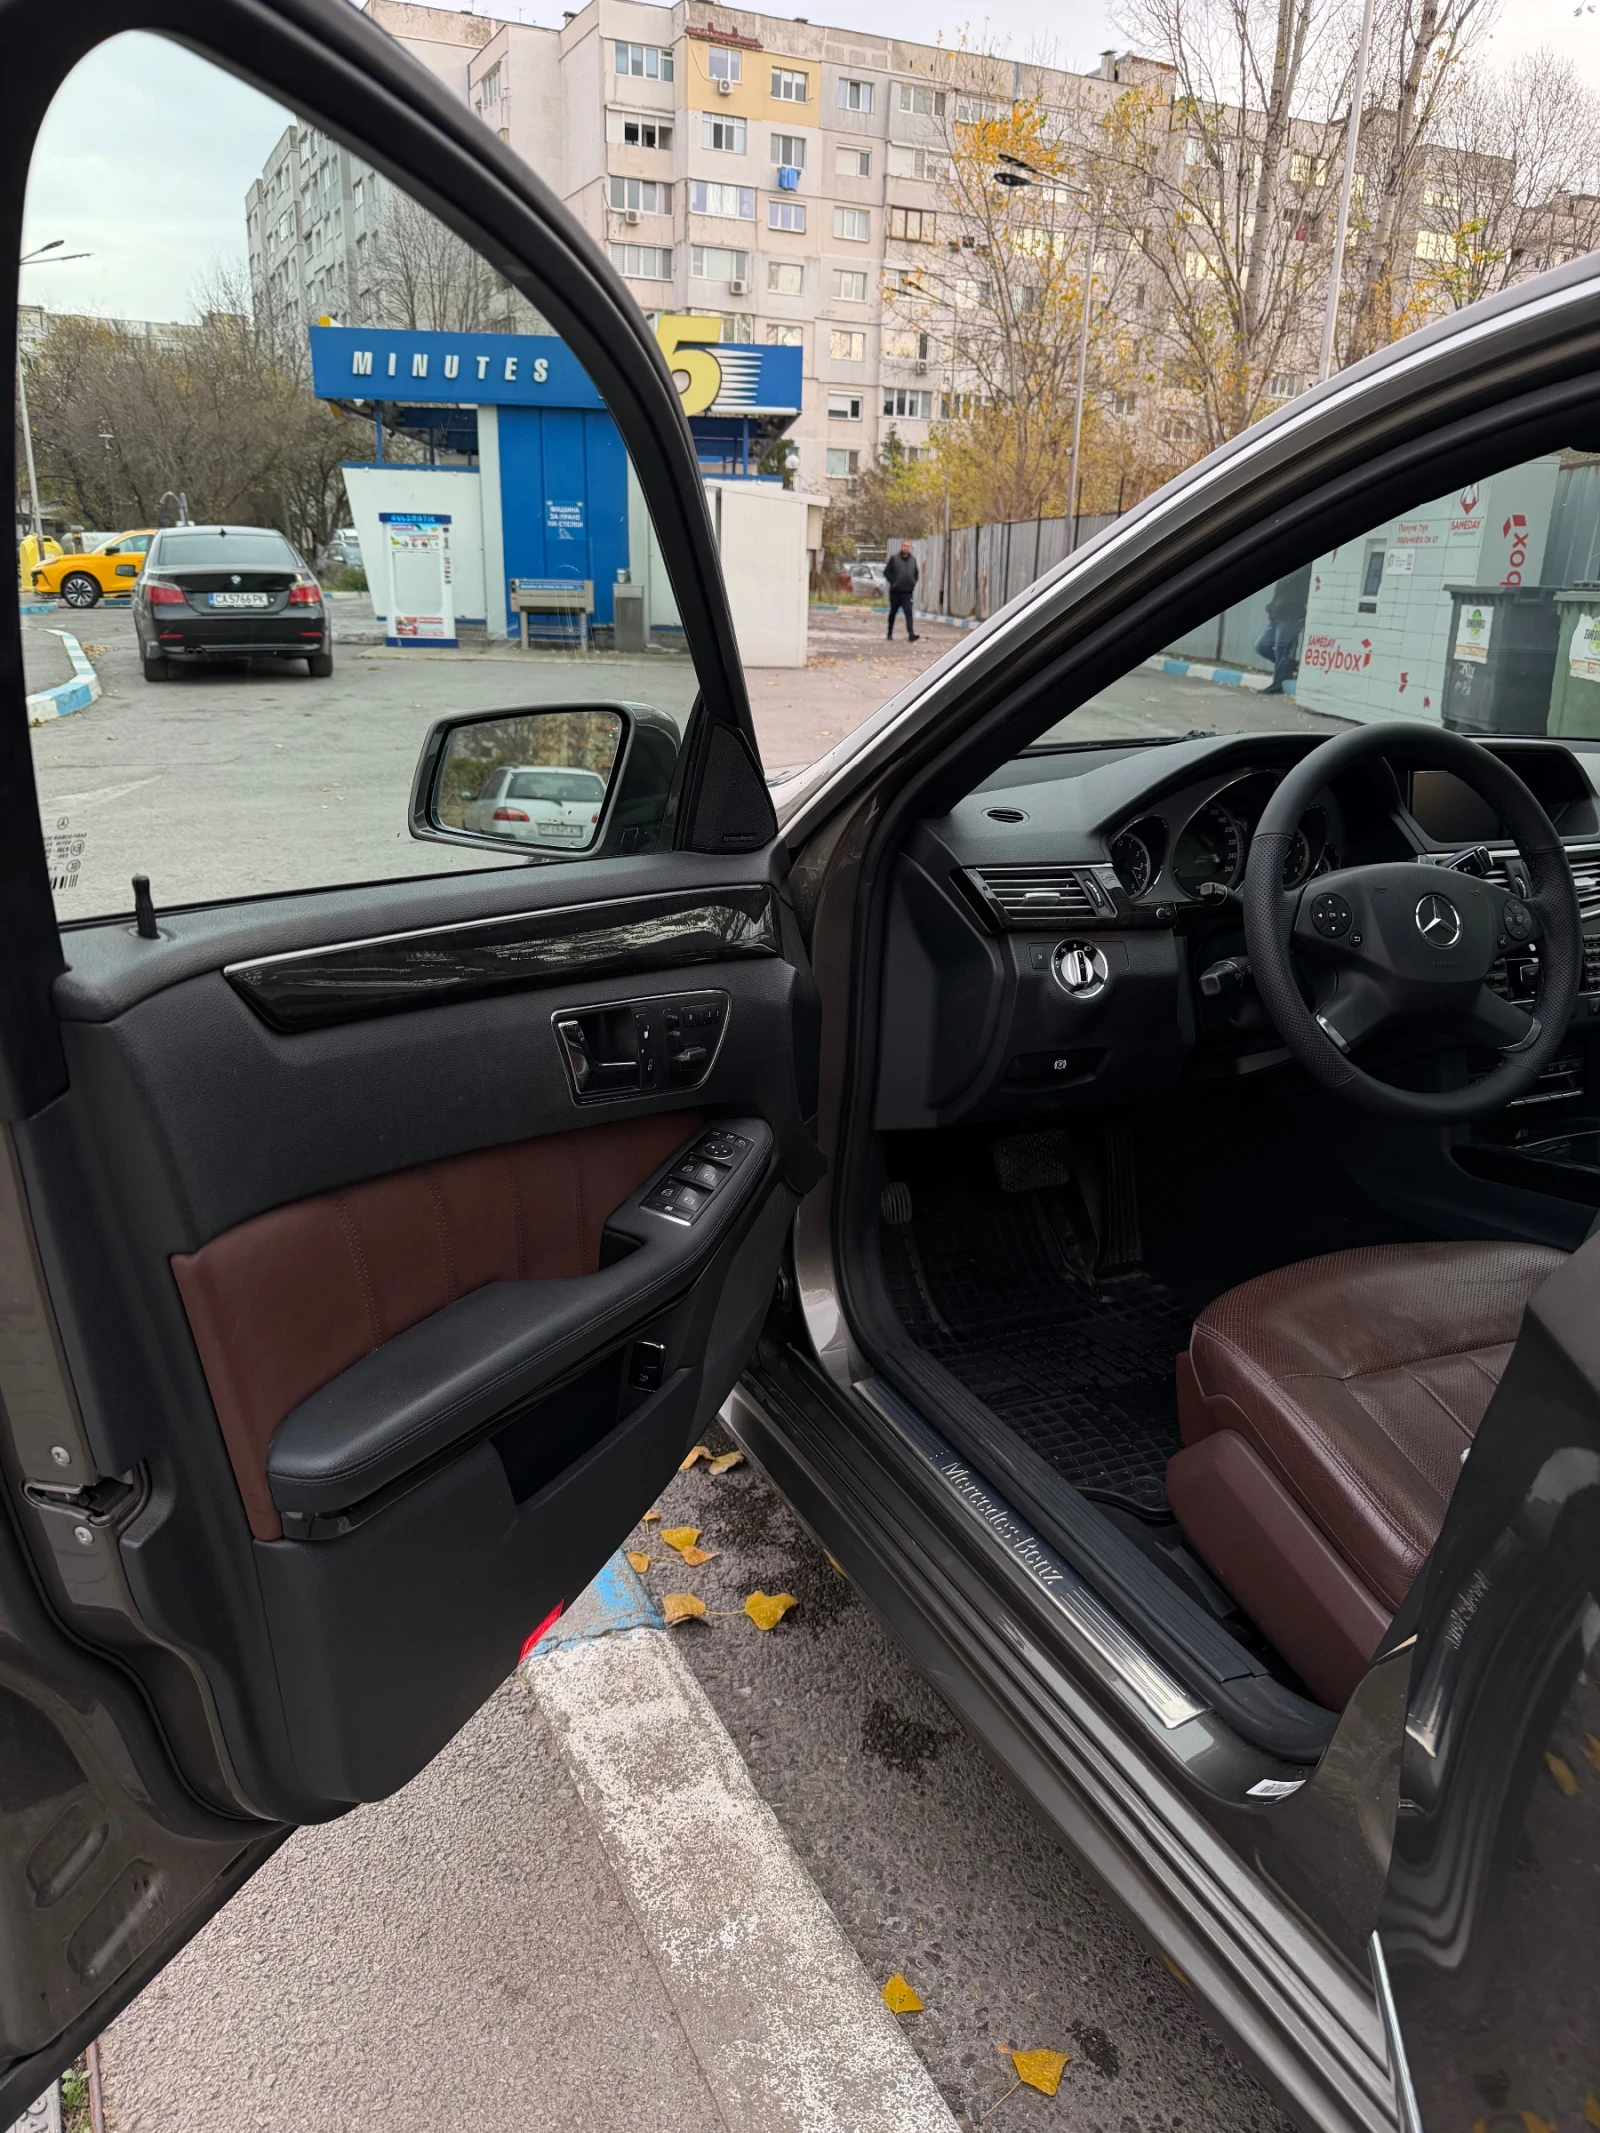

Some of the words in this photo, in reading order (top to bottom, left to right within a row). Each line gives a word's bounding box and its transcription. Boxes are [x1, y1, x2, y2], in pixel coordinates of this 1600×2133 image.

[352, 351, 549, 383] MINUTES
[656, 314, 722, 418] 5
[1451, 520, 1480, 530] SAMEDAY
[1308, 636, 1336, 648] SAMEDAY
[1305, 645, 1362, 674] easybox
[941, 1462, 1063, 1585] Mercedes-Benz
